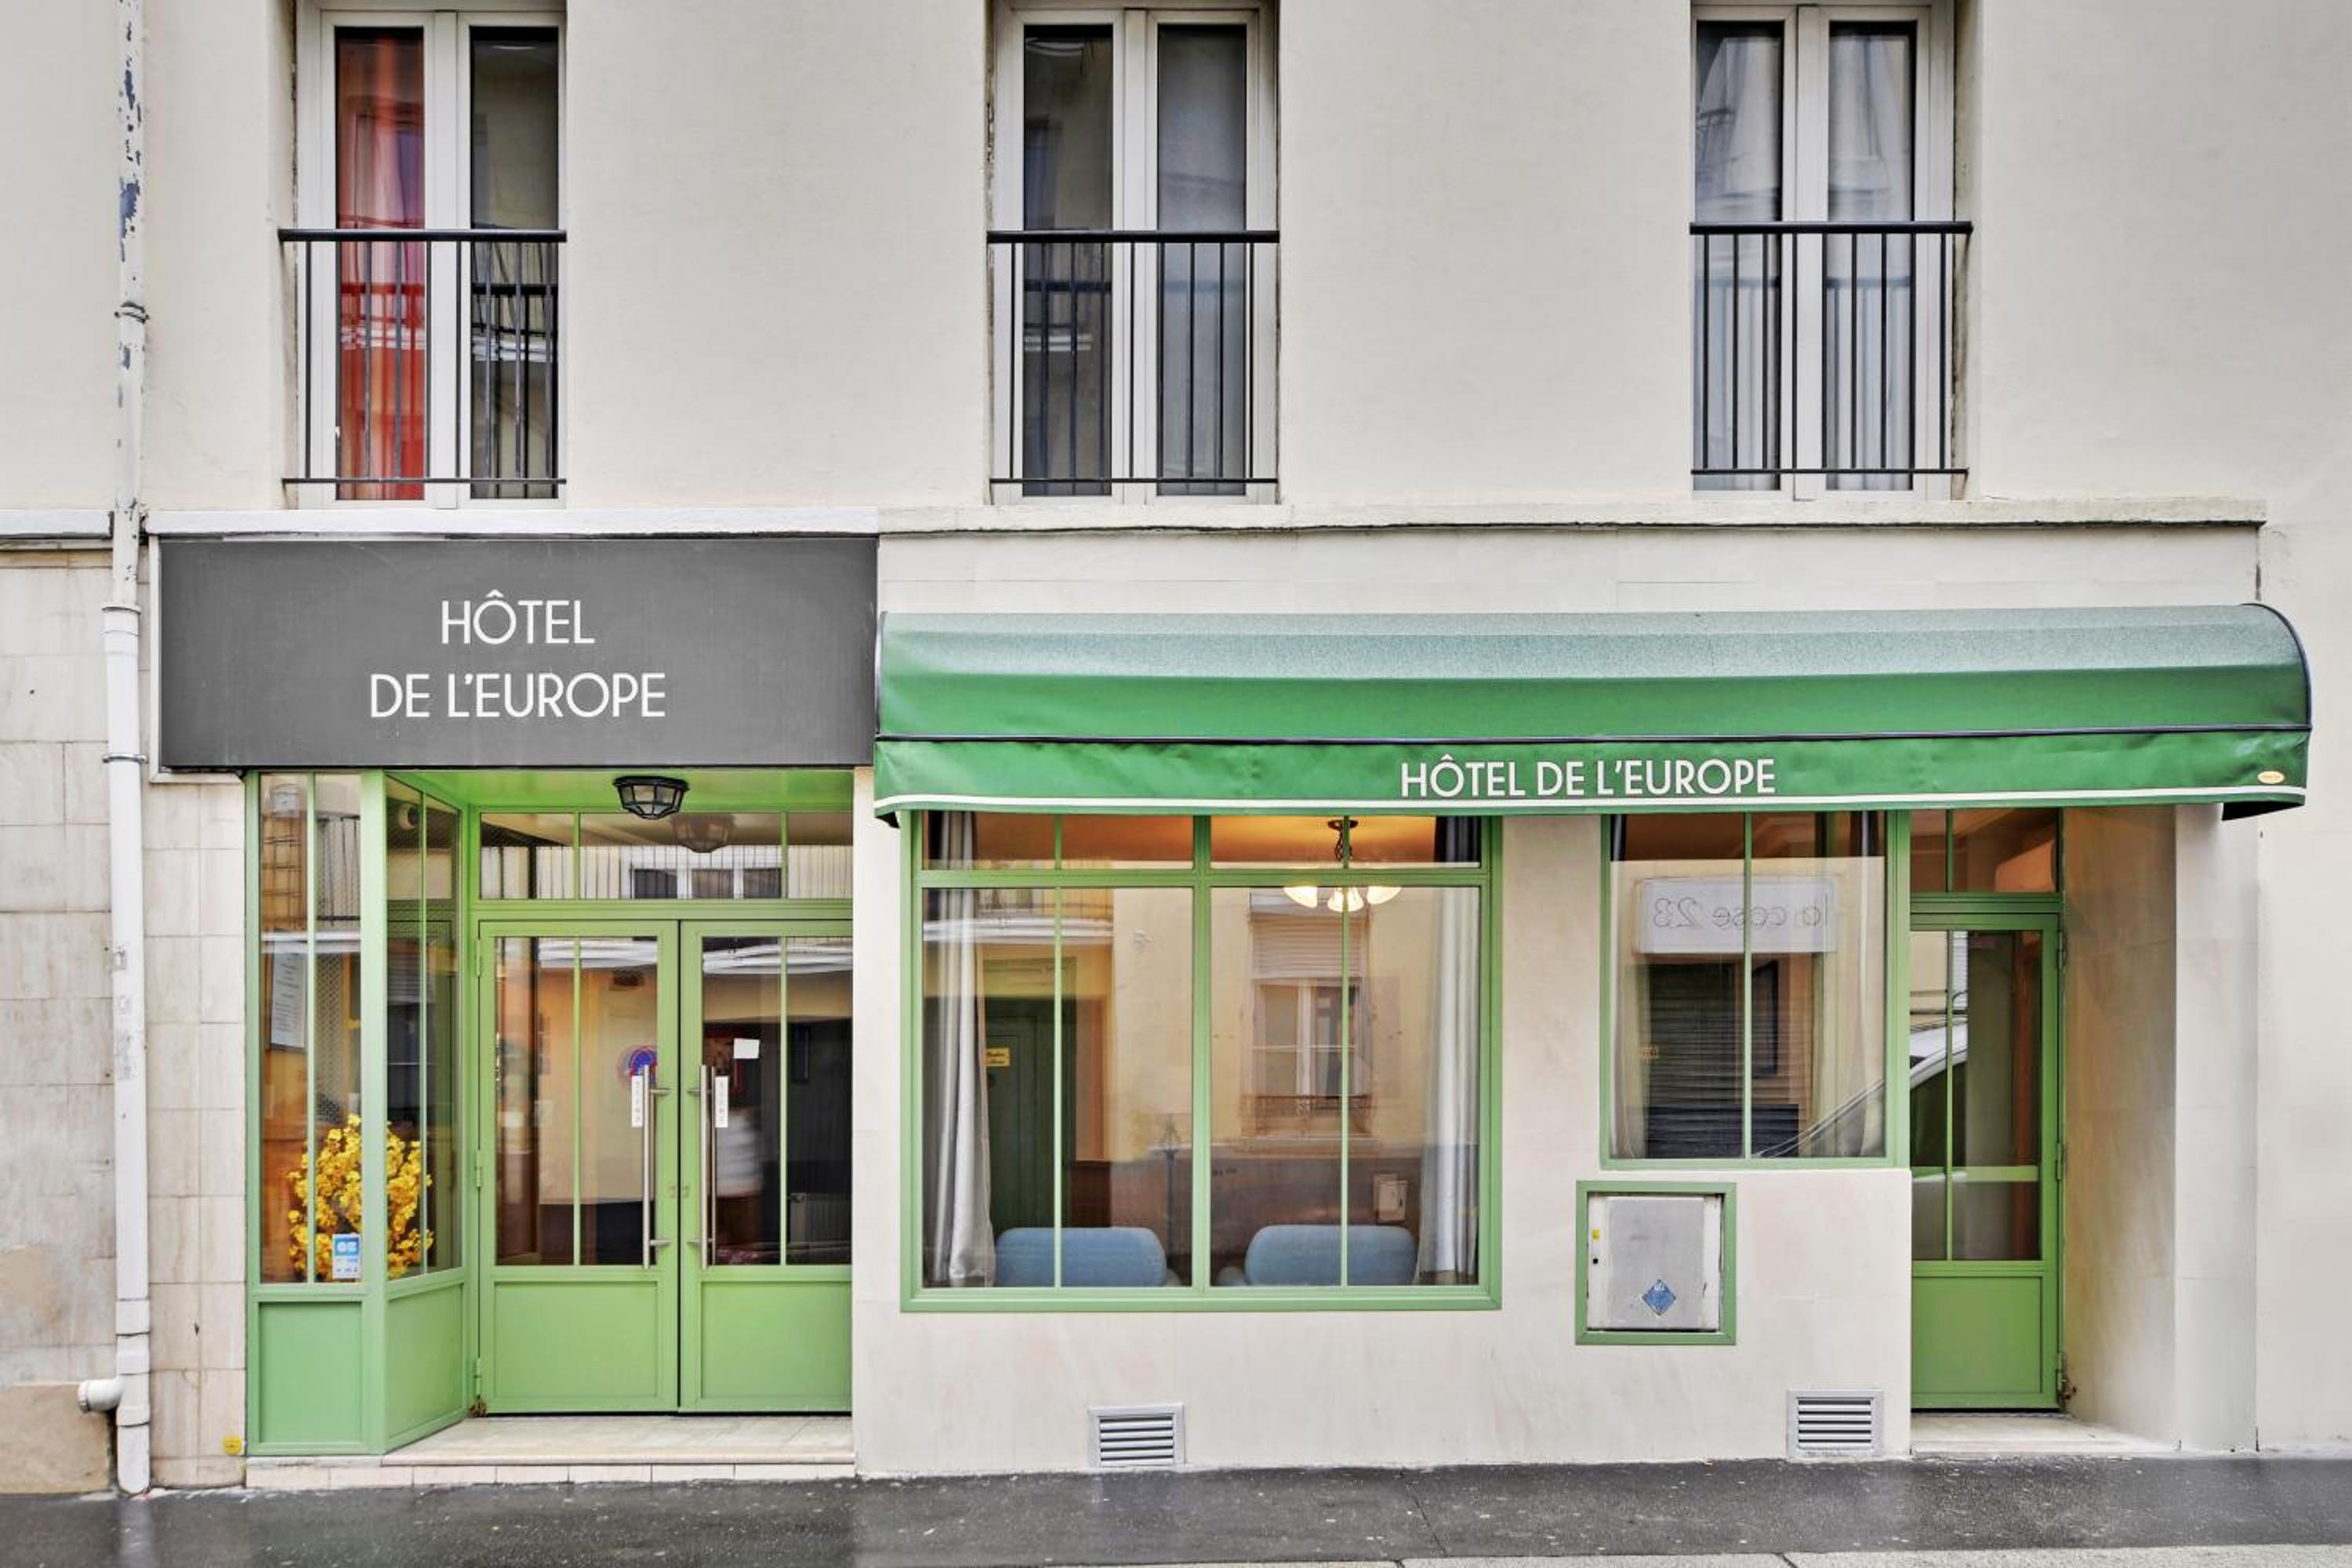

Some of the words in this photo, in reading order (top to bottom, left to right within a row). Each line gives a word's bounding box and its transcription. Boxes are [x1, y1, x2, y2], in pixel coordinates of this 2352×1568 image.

[441, 589, 596, 644] HÔTEL
[370, 673, 430, 718] DE
[448, 673, 666, 718] L'EUROPE
[1400, 753, 1526, 798] HÔTEL
[1537, 760, 1584, 797] DE
[1596, 757, 1776, 795] L'EUROPE
